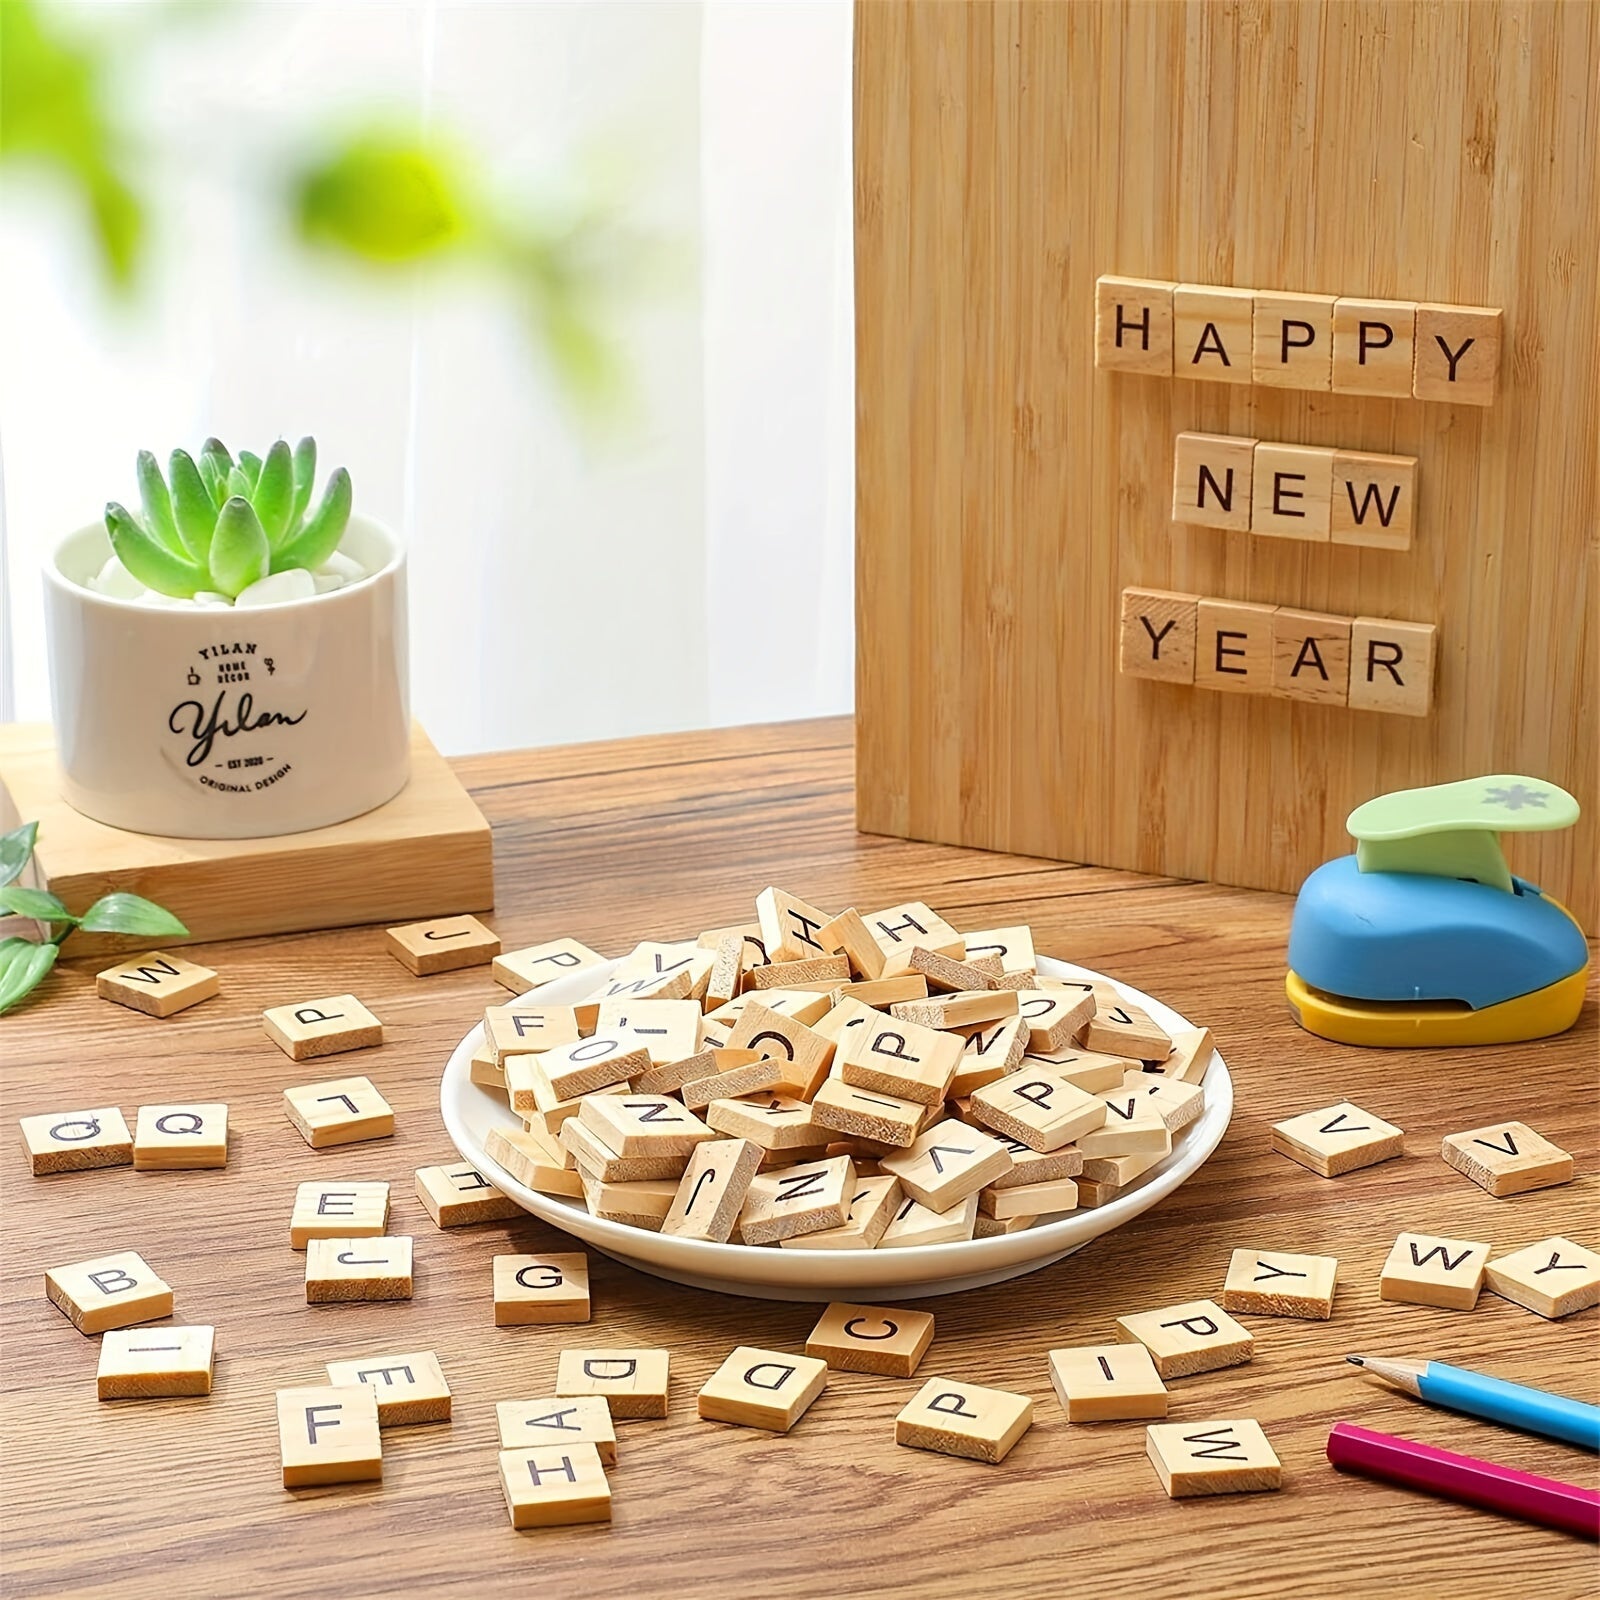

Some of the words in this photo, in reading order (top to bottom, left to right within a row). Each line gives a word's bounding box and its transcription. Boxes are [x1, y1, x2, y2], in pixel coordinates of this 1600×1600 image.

[1115, 304, 1475, 382] HAPPY
[1197, 464, 1400, 528] NEW
[198, 642, 258, 660] YILAN
[1140, 616, 1404, 687] YEAR
[199, 775, 252, 793] ORIGINAL
[255, 763, 292, 790] DESIGN
[424, 930, 470, 941] J
[877, 914, 928, 942] H
[119, 959, 182, 984] W
[532, 952, 582, 967] P
[294, 1008, 345, 1025] P
[512, 1016, 544, 1037] F
[569, 1040, 618, 1062] O
[871, 1031, 920, 1062] P
[1014, 1081, 1055, 1110] P
[155, 1113, 203, 1135] Q
[622, 1103, 685, 1123] N
[1318, 1114, 1371, 1134] V
[1472, 1131, 1519, 1156] V
[685, 1168, 716, 1216] J
[775, 1170, 828, 1202] N
[317, 1193, 357, 1215] E
[337, 1252, 389, 1265] J
[1410, 1242, 1474, 1271] W
[1533, 1252, 1588, 1275] Y
[88, 1269, 138, 1295] B
[515, 1265, 563, 1288] G
[1253, 1261, 1306, 1282] Y
[843, 1318, 899, 1341] C
[1160, 1315, 1219, 1336] P
[583, 1358, 637, 1380] D
[743, 1363, 797, 1391] D
[1097, 1355, 1115, 1381] I
[927, 1393, 978, 1419] P
[304, 1404, 343, 1445] F
[525, 1407, 582, 1431] A
[1183, 1427, 1249, 1461] W
[526, 1455, 577, 1486] H
